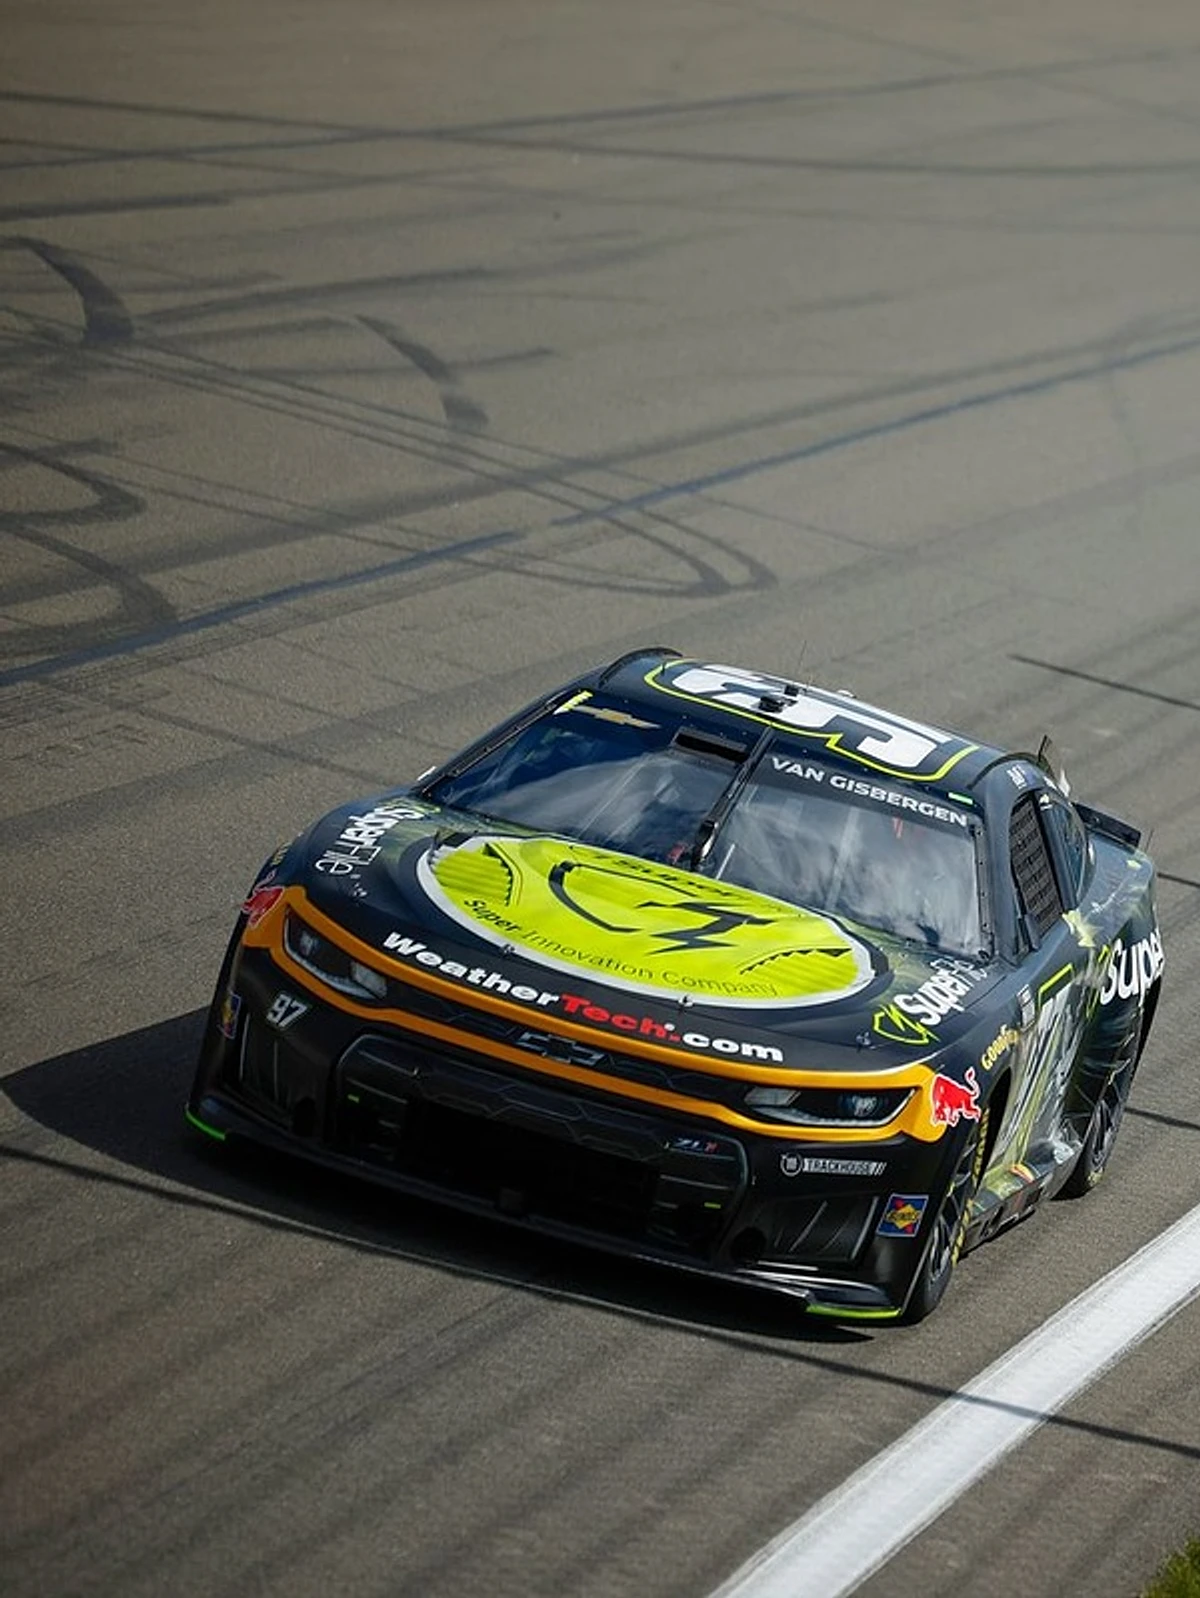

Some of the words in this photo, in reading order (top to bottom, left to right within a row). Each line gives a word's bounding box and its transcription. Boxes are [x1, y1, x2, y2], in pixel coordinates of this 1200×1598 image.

[771, 757, 825, 782] VAN
[830, 774, 968, 827] GISBERGEN
[464, 900, 522, 932] Super
[522, 930, 654, 979] Innovation
[661, 970, 778, 996] Company
[266, 993, 308, 1028] 97
[383, 932, 784, 1062] WeatherTech.com
